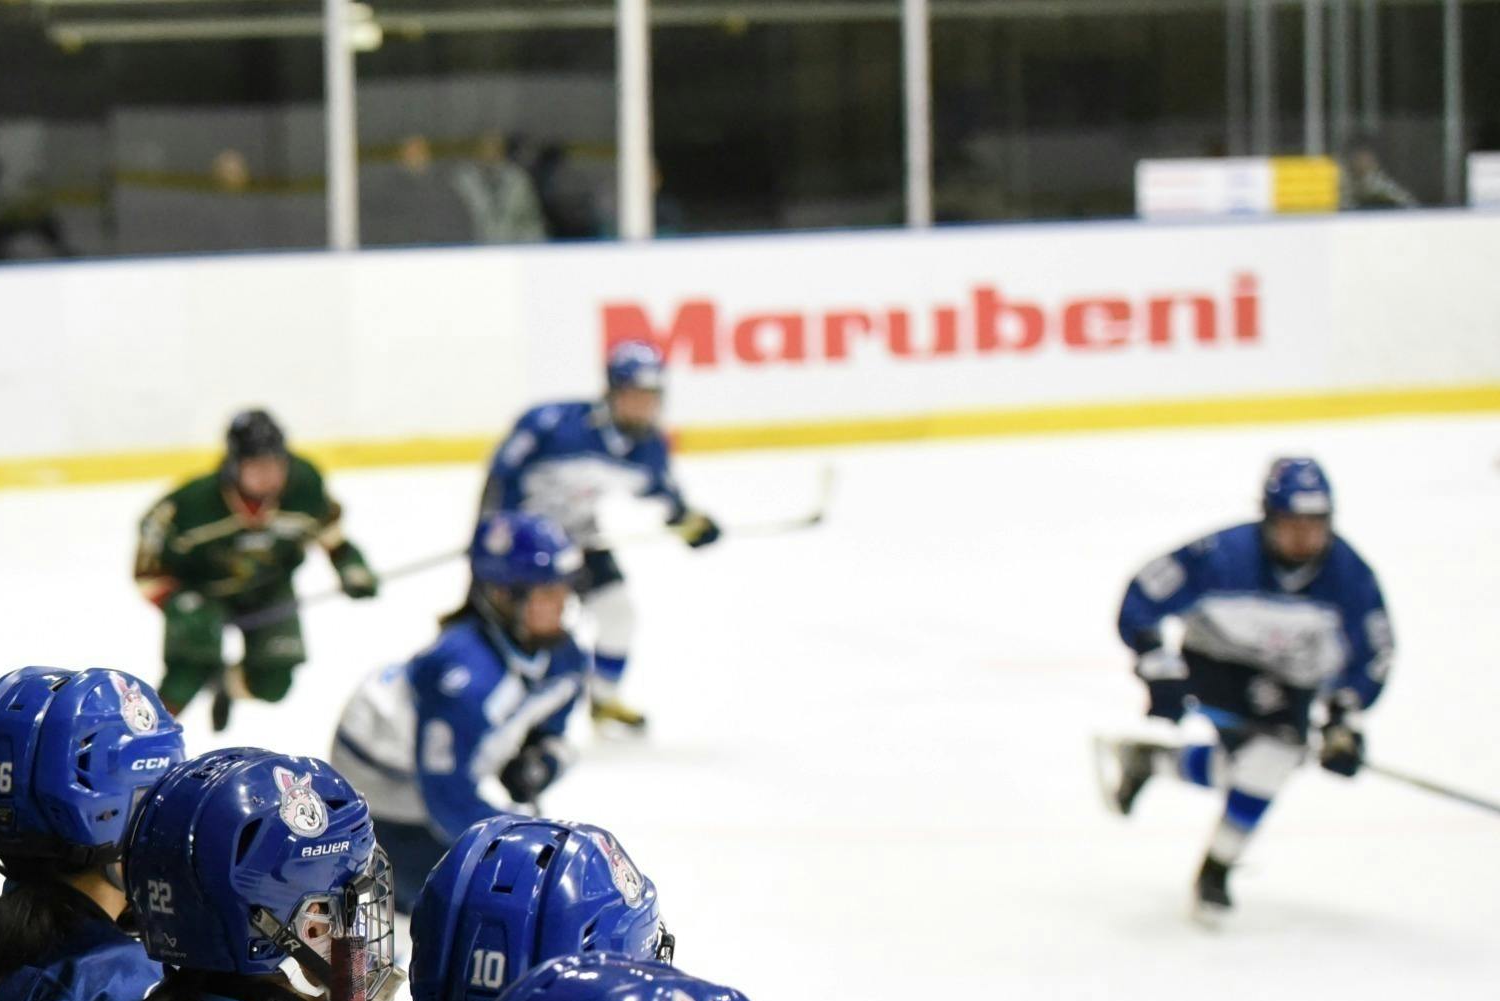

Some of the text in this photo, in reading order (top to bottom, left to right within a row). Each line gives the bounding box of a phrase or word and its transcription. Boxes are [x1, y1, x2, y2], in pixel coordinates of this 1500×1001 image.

[601, 272, 1264, 369] Marubeni
[131, 757, 171, 771] CCM
[301, 840, 349, 858] BAUER
[147, 879, 175, 915] 22
[470, 948, 506, 990] 10
